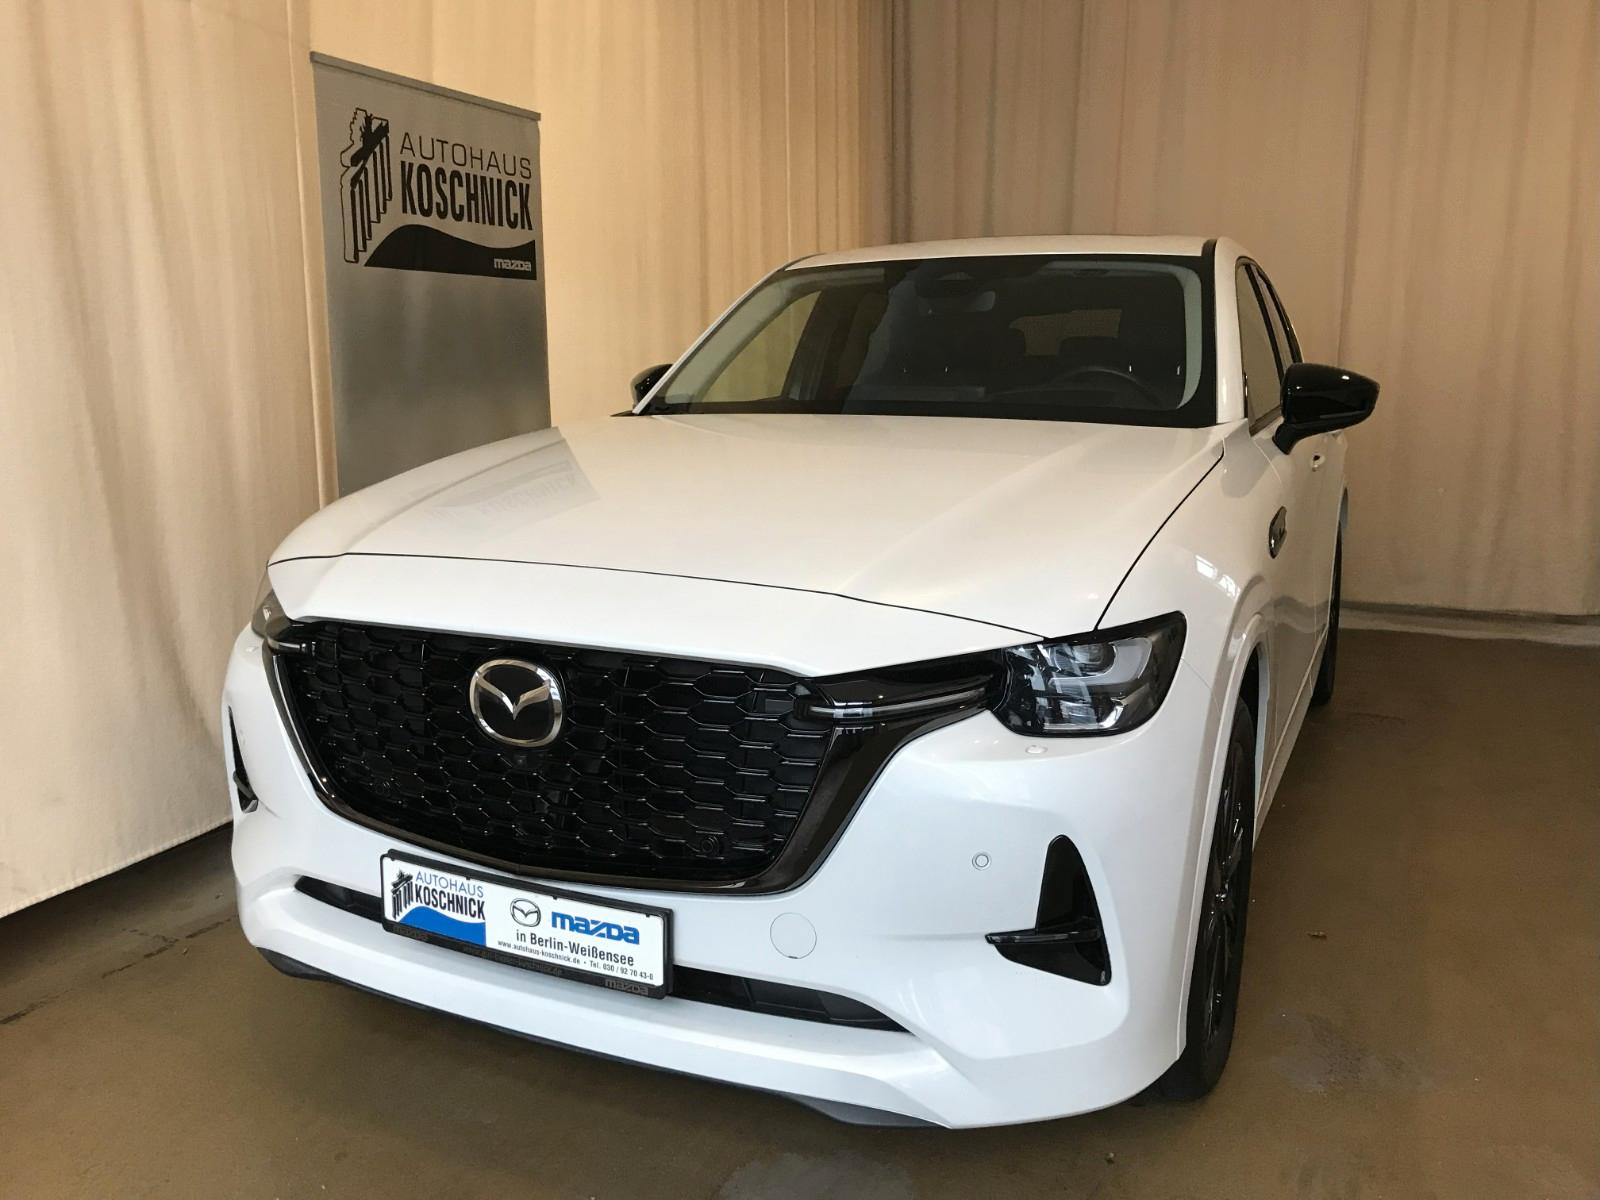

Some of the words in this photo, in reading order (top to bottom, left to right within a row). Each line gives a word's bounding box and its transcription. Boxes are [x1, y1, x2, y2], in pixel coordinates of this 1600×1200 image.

[400, 132, 532, 180] AUTOHAUS
[400, 160, 533, 231] KOSCHNICK
[493, 258, 532, 272] mazda
[415, 871, 484, 898] AUTOHAUS
[415, 884, 485, 920] KOSCHNICK
[551, 911, 640, 945] mazda
[516, 929, 526, 942] in
[530, 932, 635, 967] Berlin-Weißensee
[590, 960, 601, 970] Tel.
[602, 963, 615, 973] 030
[620, 967, 628, 975] 92
[604, 979, 649, 995] mazda
